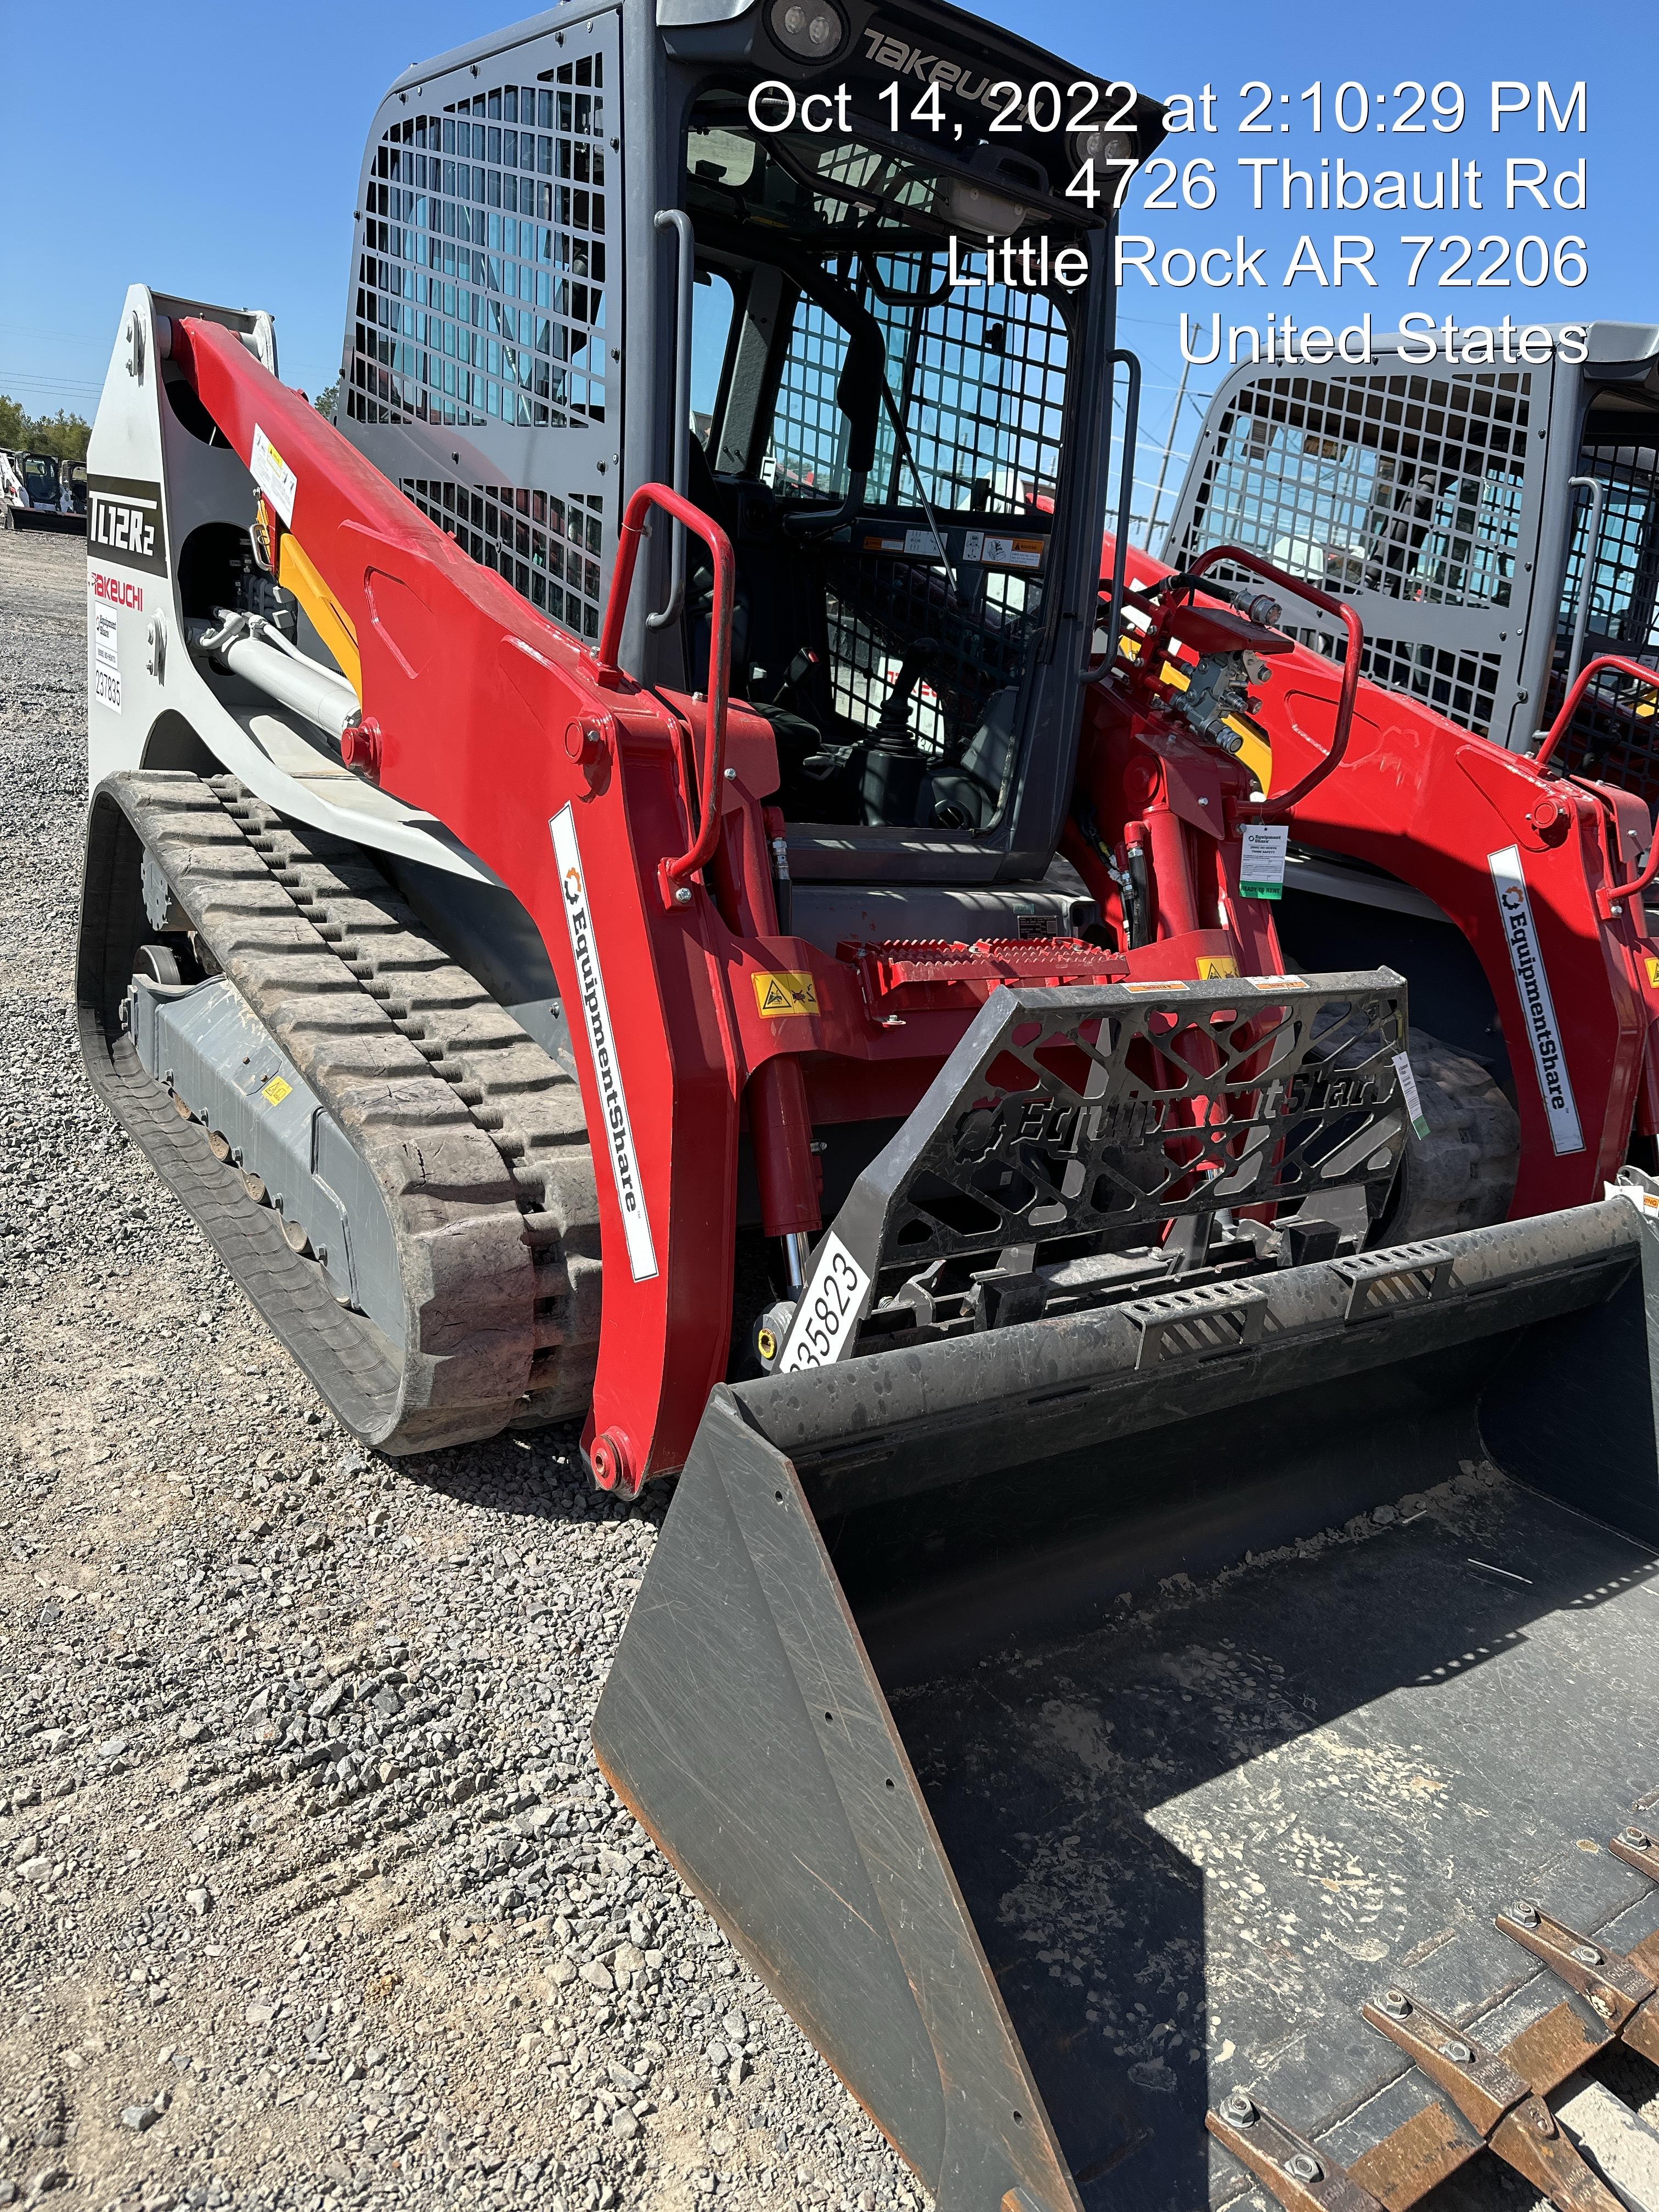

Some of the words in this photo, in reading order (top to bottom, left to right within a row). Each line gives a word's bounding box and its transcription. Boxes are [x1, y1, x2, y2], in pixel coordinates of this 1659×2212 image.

[89, 490, 157, 556] TL12R2
[95, 669, 120, 706] 237835
[572, 907, 636, 1213] EquipmentShare
[1509, 911, 1565, 1110] EquipmentShare
[789, 1252, 858, 1372] 35823
